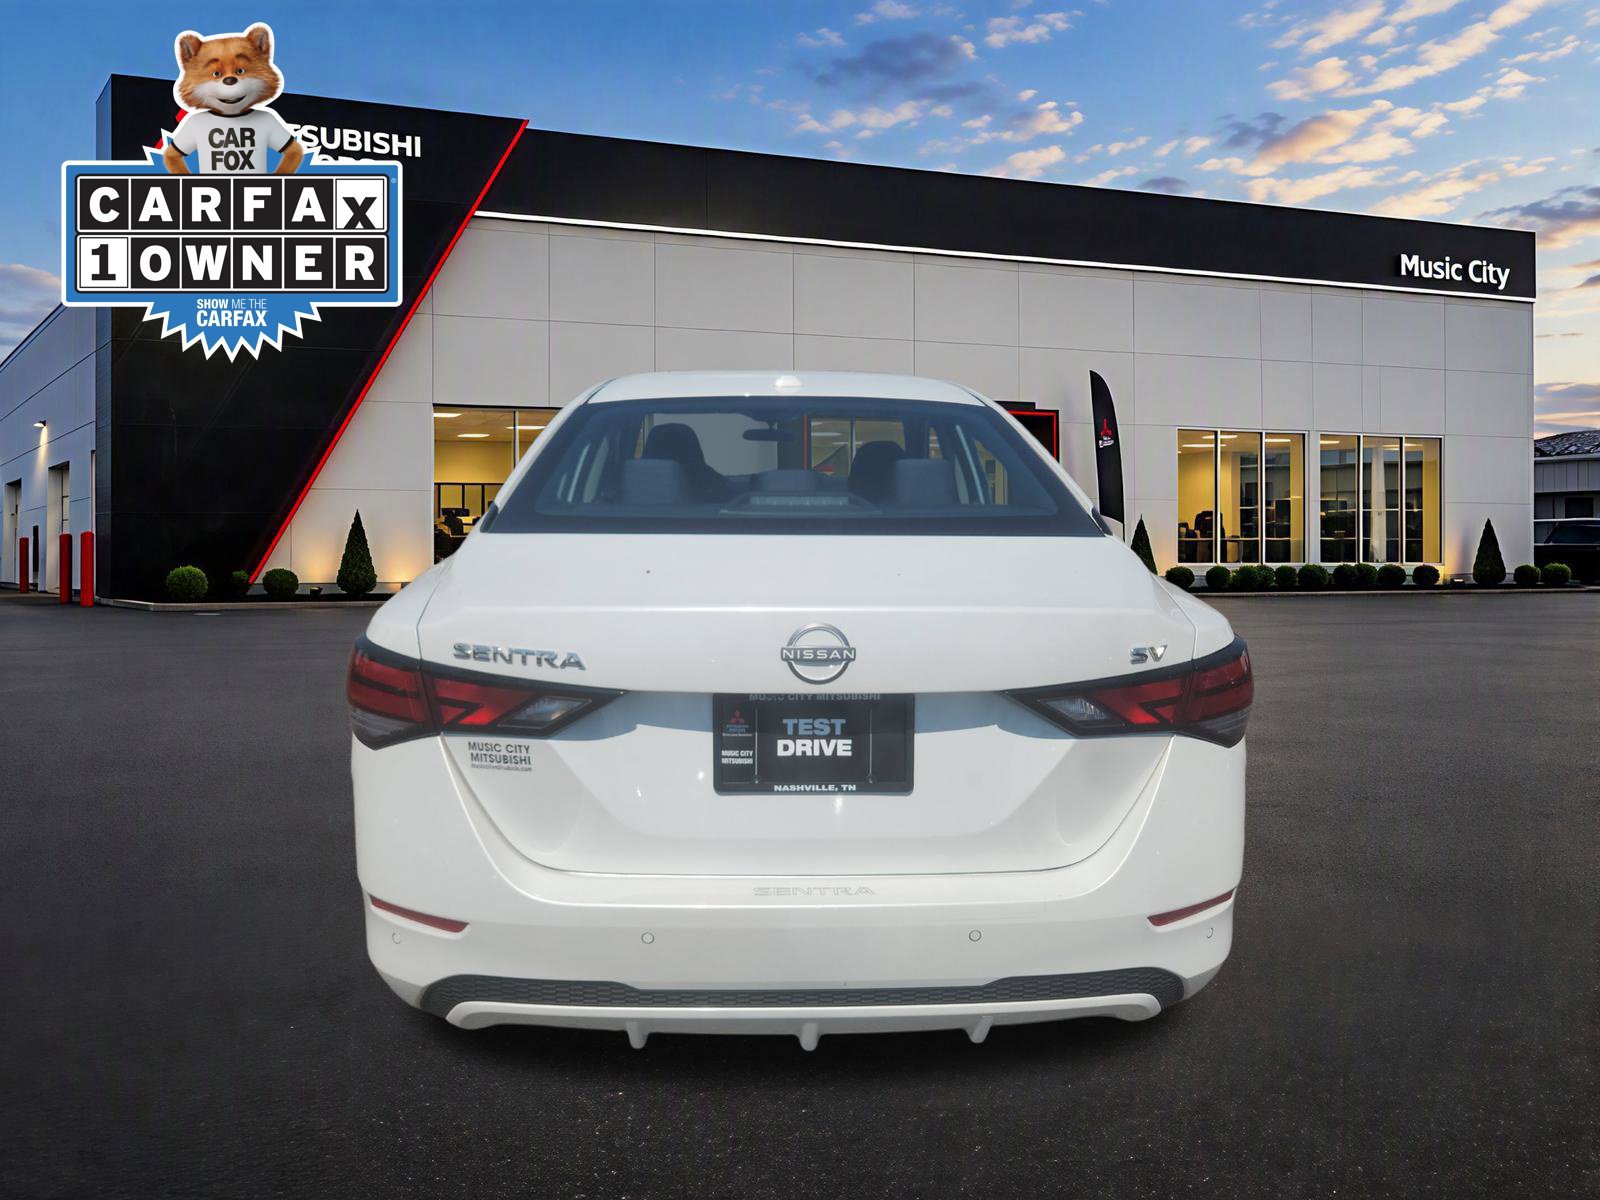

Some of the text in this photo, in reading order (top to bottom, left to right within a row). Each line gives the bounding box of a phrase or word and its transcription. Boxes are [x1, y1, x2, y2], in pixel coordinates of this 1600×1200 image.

[1400, 253, 1511, 290] Music City
[453, 642, 587, 671] SENTRA
[781, 648, 856, 660] NISSAN
[1130, 644, 1168, 665] SV
[782, 718, 846, 736] TEST
[468, 741, 530, 754] MUSIC CITY
[776, 739, 853, 757] DRIVE
[470, 752, 532, 766] MITSUBISHI
[773, 784, 857, 792] NASHVILLE, TN
[751, 886, 877, 897] SENTRA
